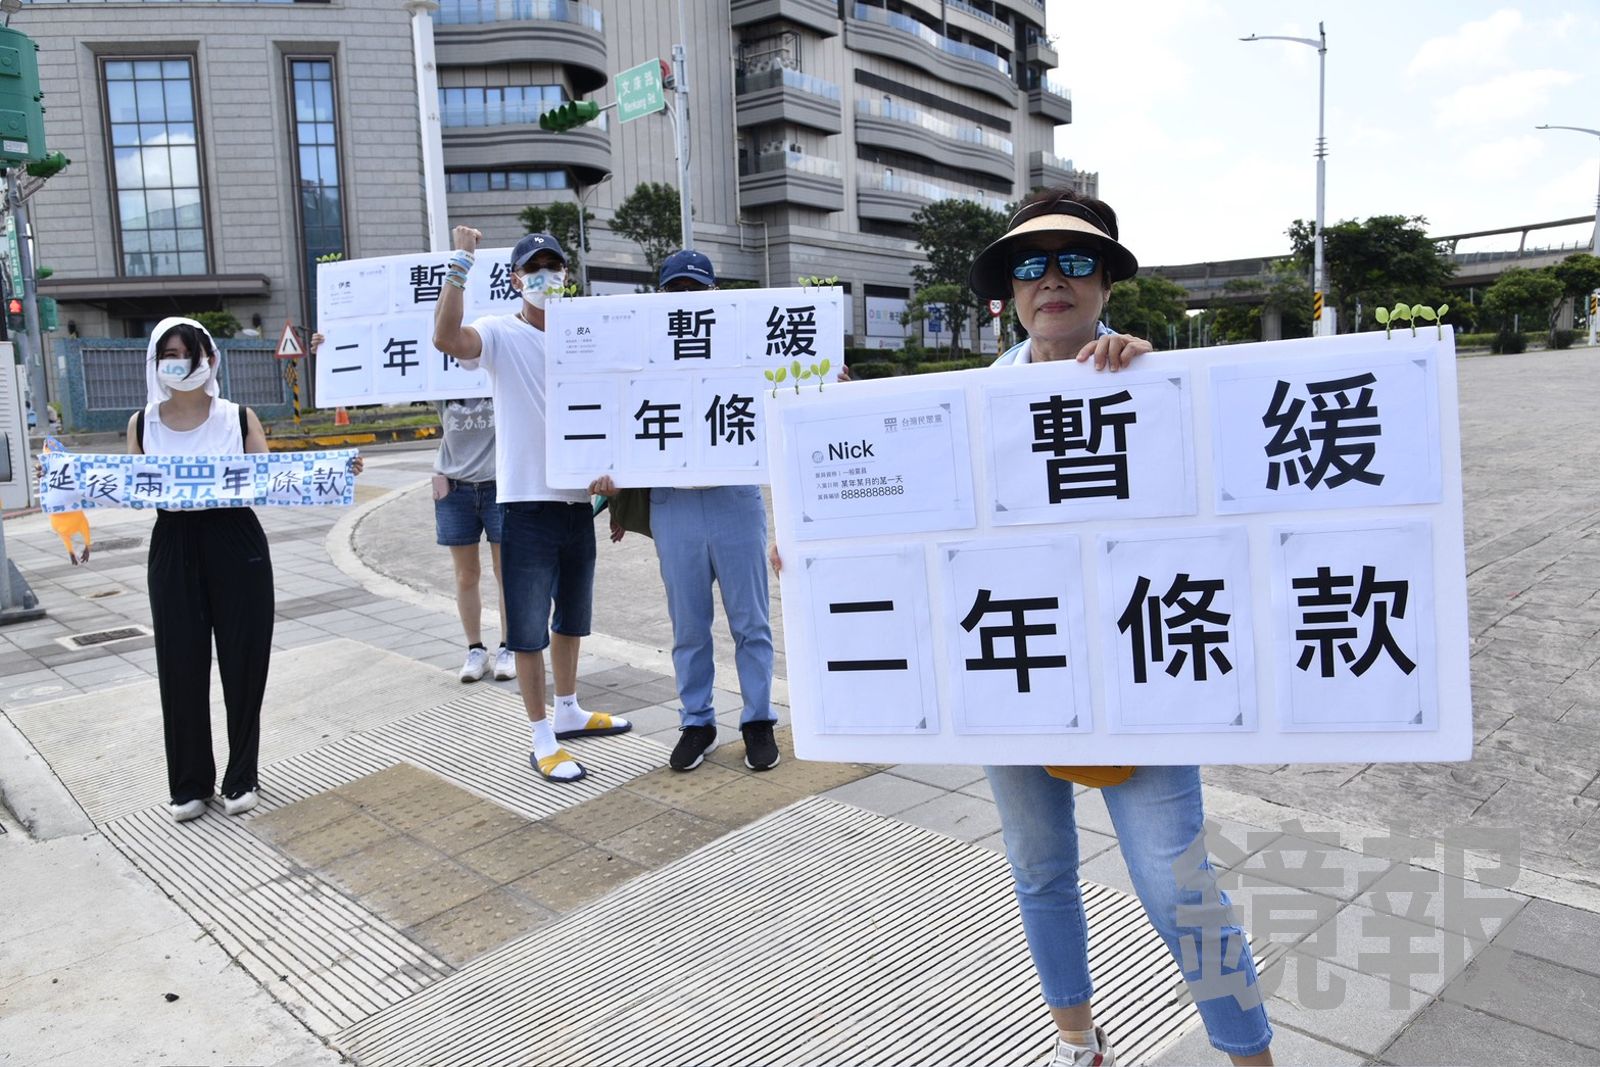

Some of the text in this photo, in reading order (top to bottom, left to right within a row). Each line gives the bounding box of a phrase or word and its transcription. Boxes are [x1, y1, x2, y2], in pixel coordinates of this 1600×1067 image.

[666, 305, 818, 361] 暫緩
[563, 392, 758, 452] 二年條
[828, 440, 875, 462] Nick
[1030, 372, 1385, 504] 暫緩
[827, 566, 1417, 693] 二年條款
